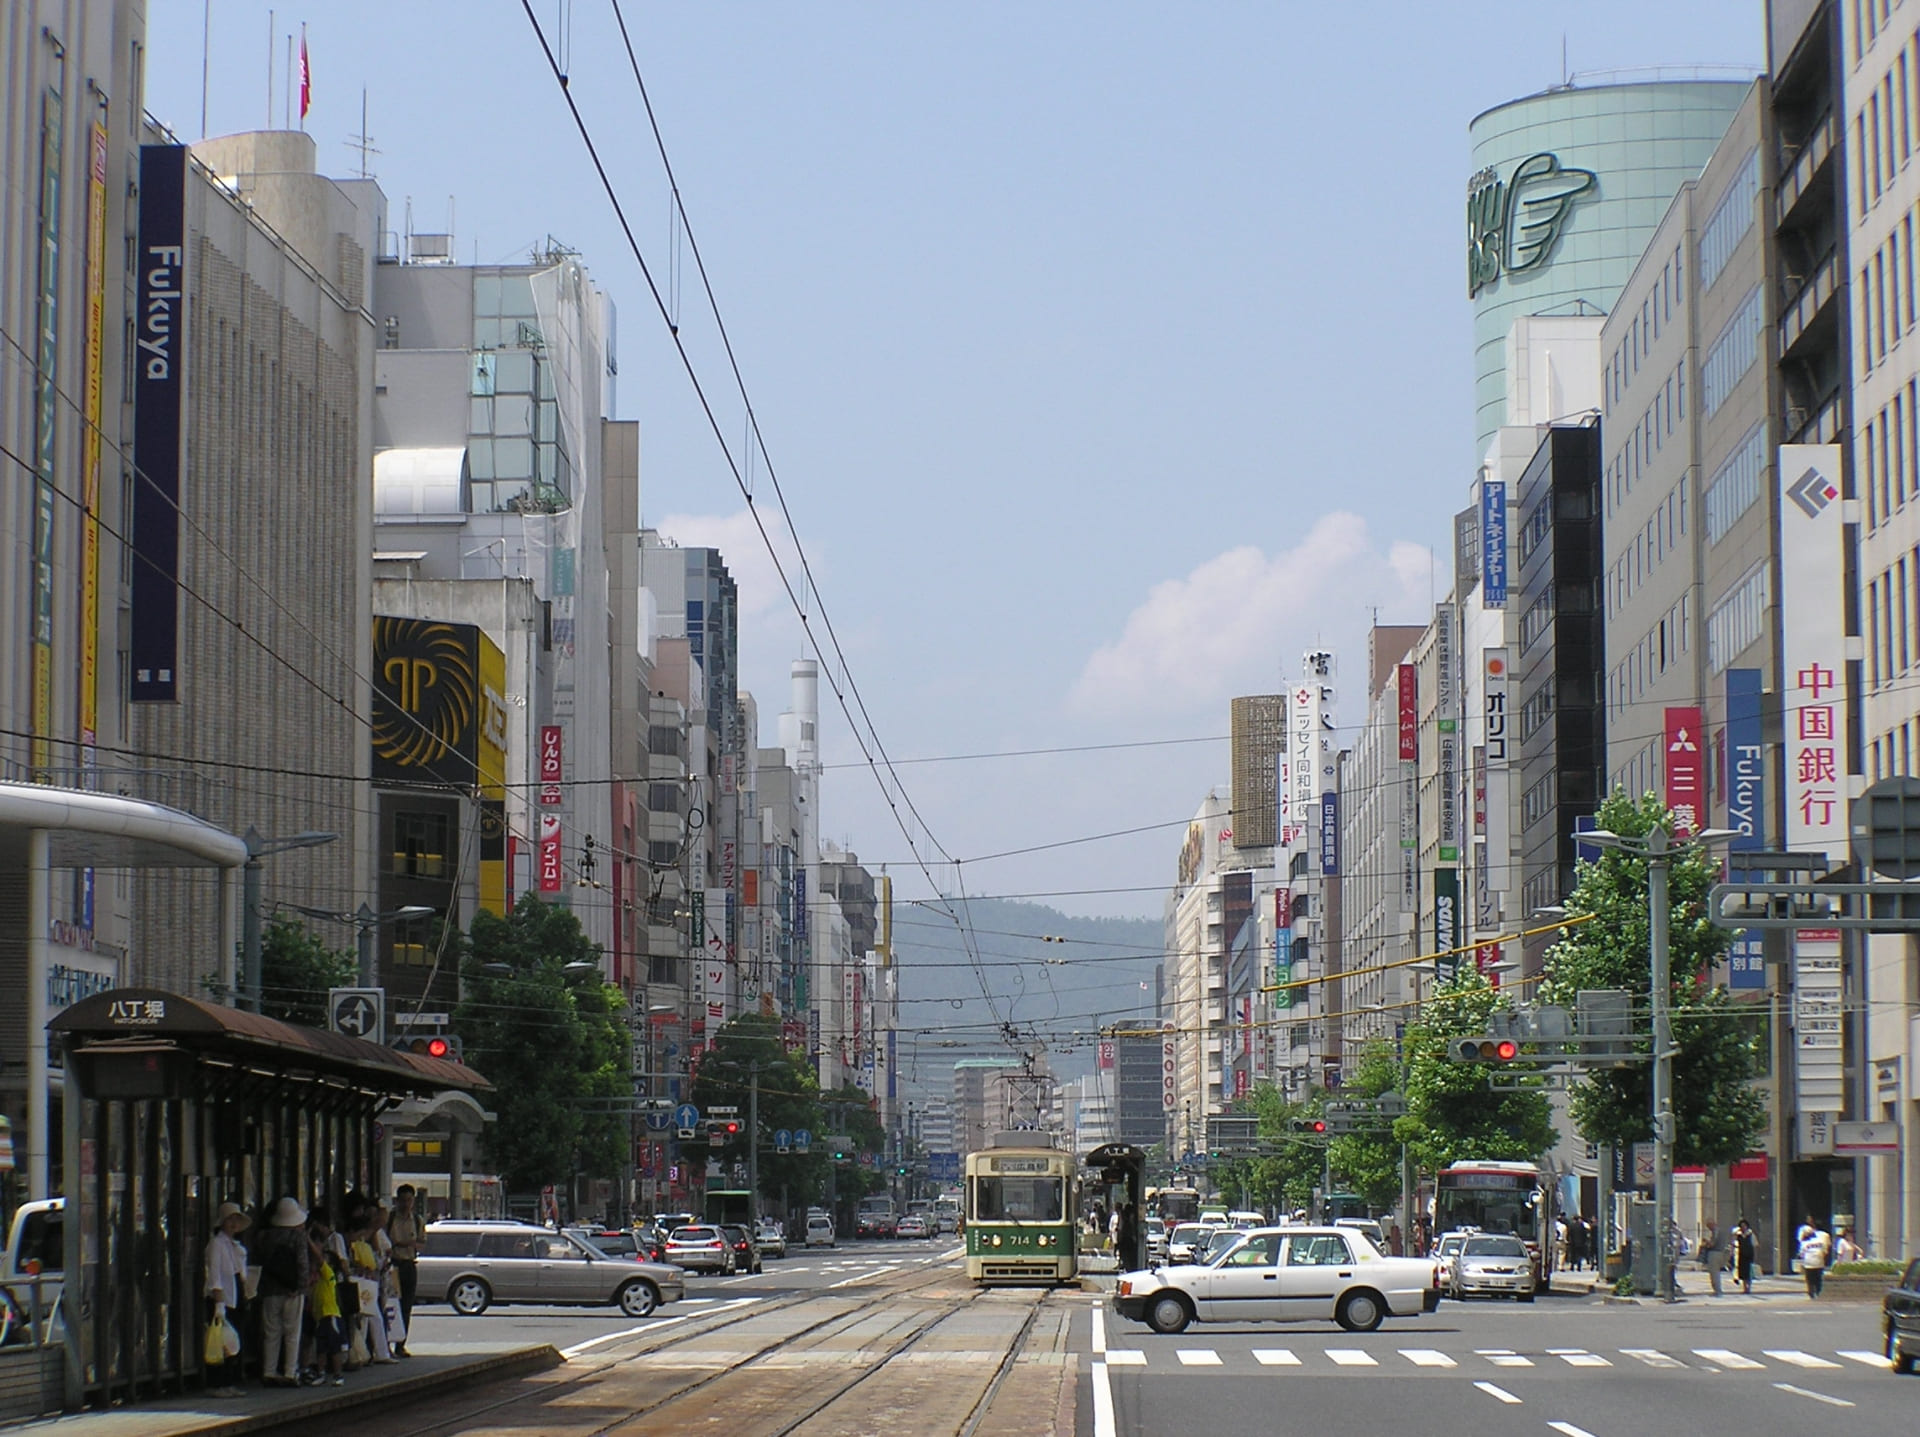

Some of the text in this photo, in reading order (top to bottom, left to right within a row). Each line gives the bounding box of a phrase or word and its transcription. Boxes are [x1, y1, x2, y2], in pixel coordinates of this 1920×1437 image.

[138, 246, 182, 380] Fukuya
[1486, 483, 1503, 586] アートネイチャー
[544, 731, 559, 772] しんわ
[1487, 692, 1506, 759] オリコ
[1797, 662, 1836, 826] 中国銀行
[1296, 705, 1311, 817] ニッセイ同和損保
[1729, 745, 1761, 838] Fukuya
[1673, 766, 1697, 832] 三菱
[544, 842, 558, 880] アコム
[723, 842, 735, 889] アデランス
[1438, 895, 1454, 958] HANDS
[108, 1000, 166, 1018] 八丁堀
[1164, 1042, 1175, 1106] SOGO
[1010, 1235, 1030, 1246] 714
